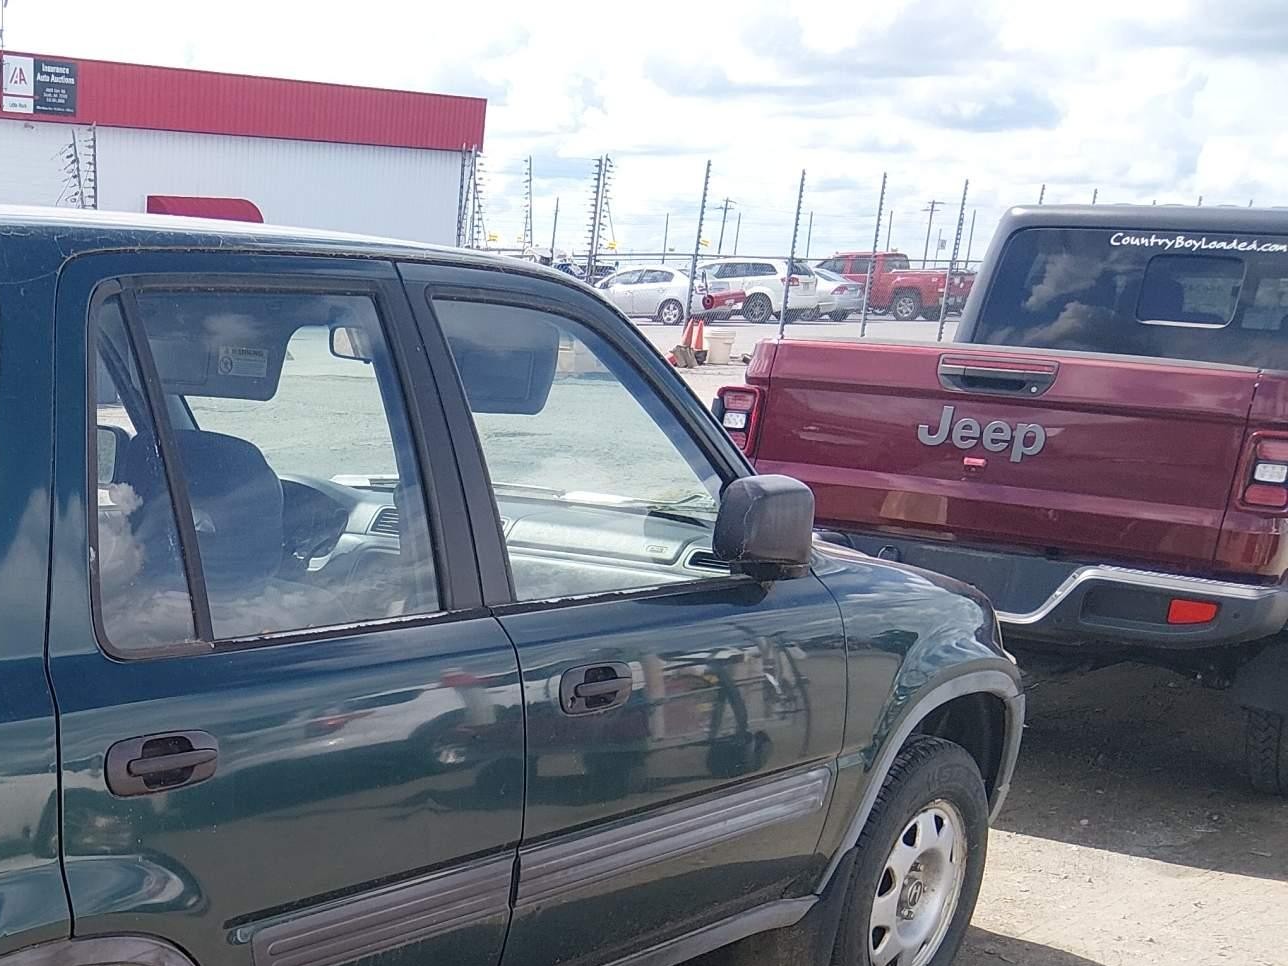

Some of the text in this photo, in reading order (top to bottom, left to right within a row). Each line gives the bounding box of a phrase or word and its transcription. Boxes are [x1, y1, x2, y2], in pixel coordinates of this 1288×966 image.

[36, 72, 50, 82] Auto
[1110, 232, 1288, 252] CountryBoyLoaded.com
[917, 405, 1047, 463] Jeep
